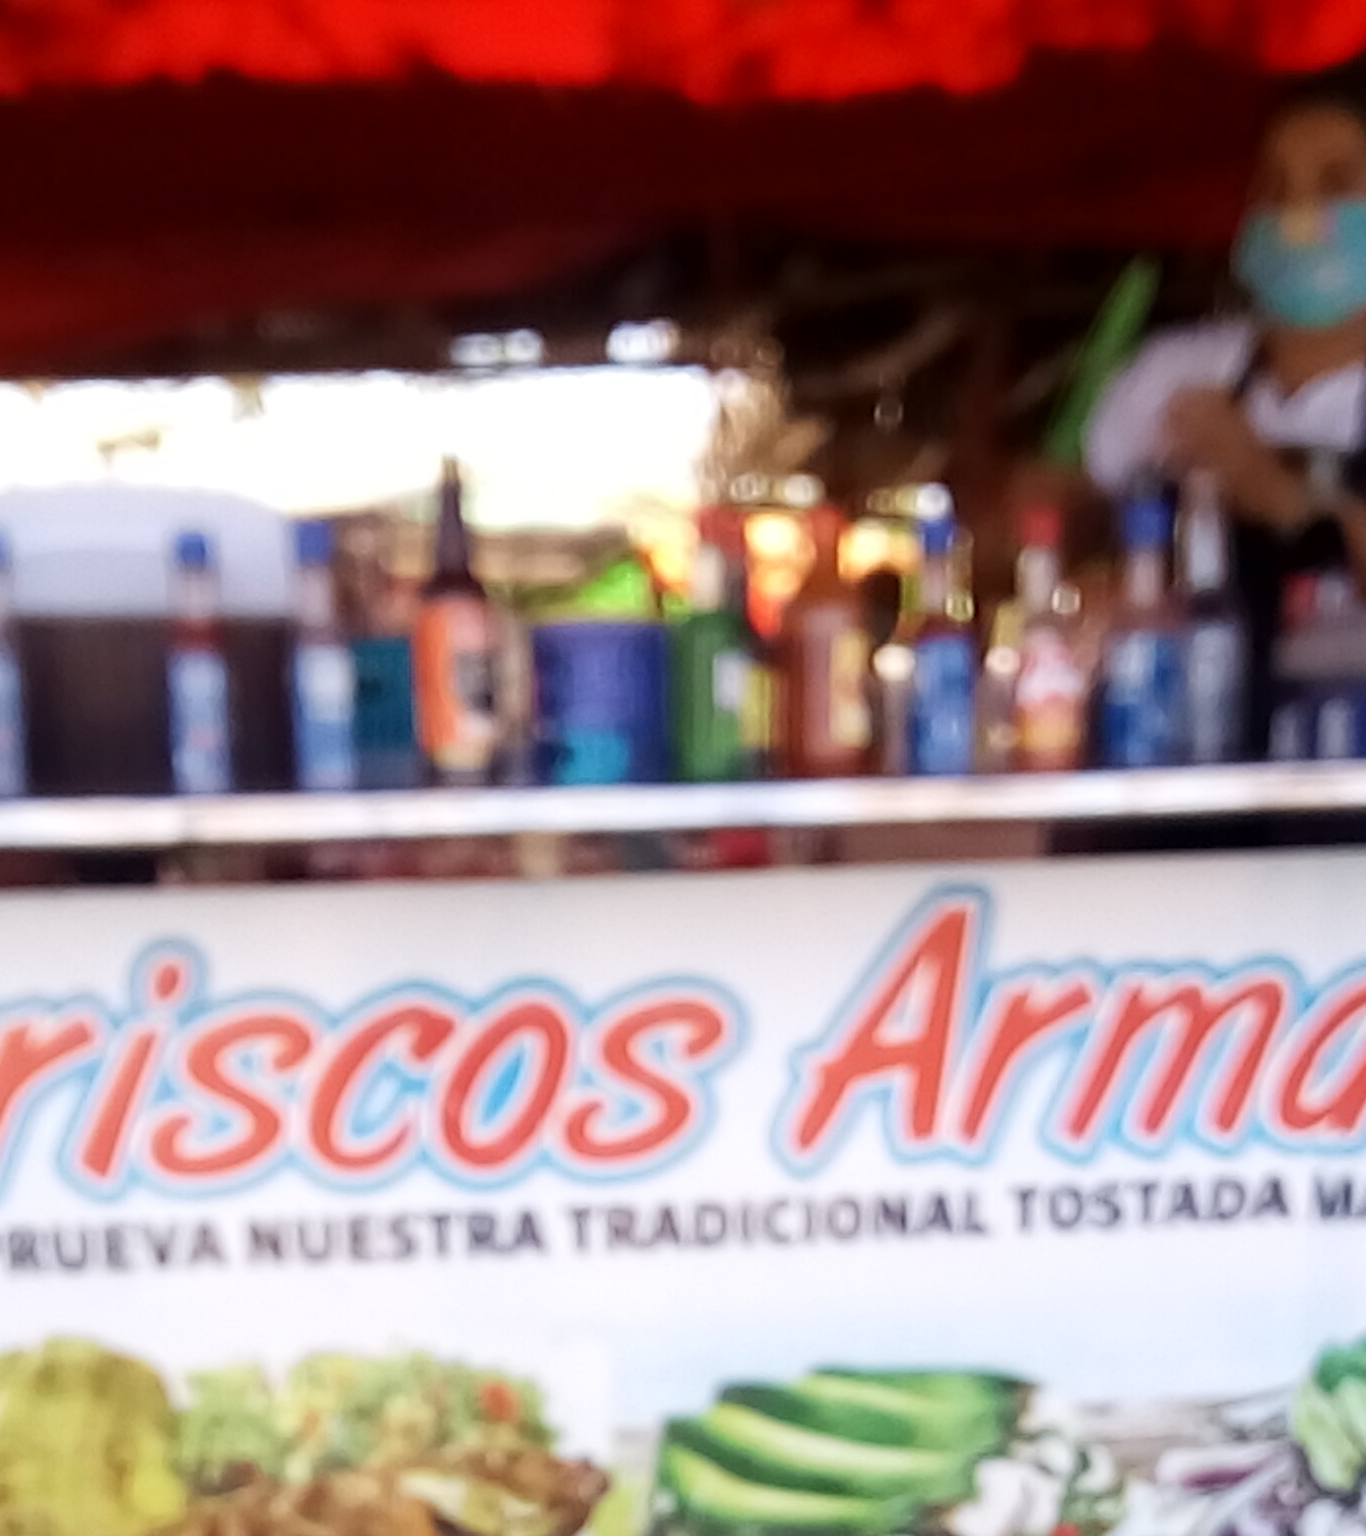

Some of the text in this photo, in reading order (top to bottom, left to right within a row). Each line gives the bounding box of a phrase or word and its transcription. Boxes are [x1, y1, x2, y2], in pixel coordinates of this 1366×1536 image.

[245, 1208, 549, 1264] NUESTRA
[569, 1188, 989, 1255] TRADICIONAL
[1011, 1175, 1293, 1234] TOSTADA
